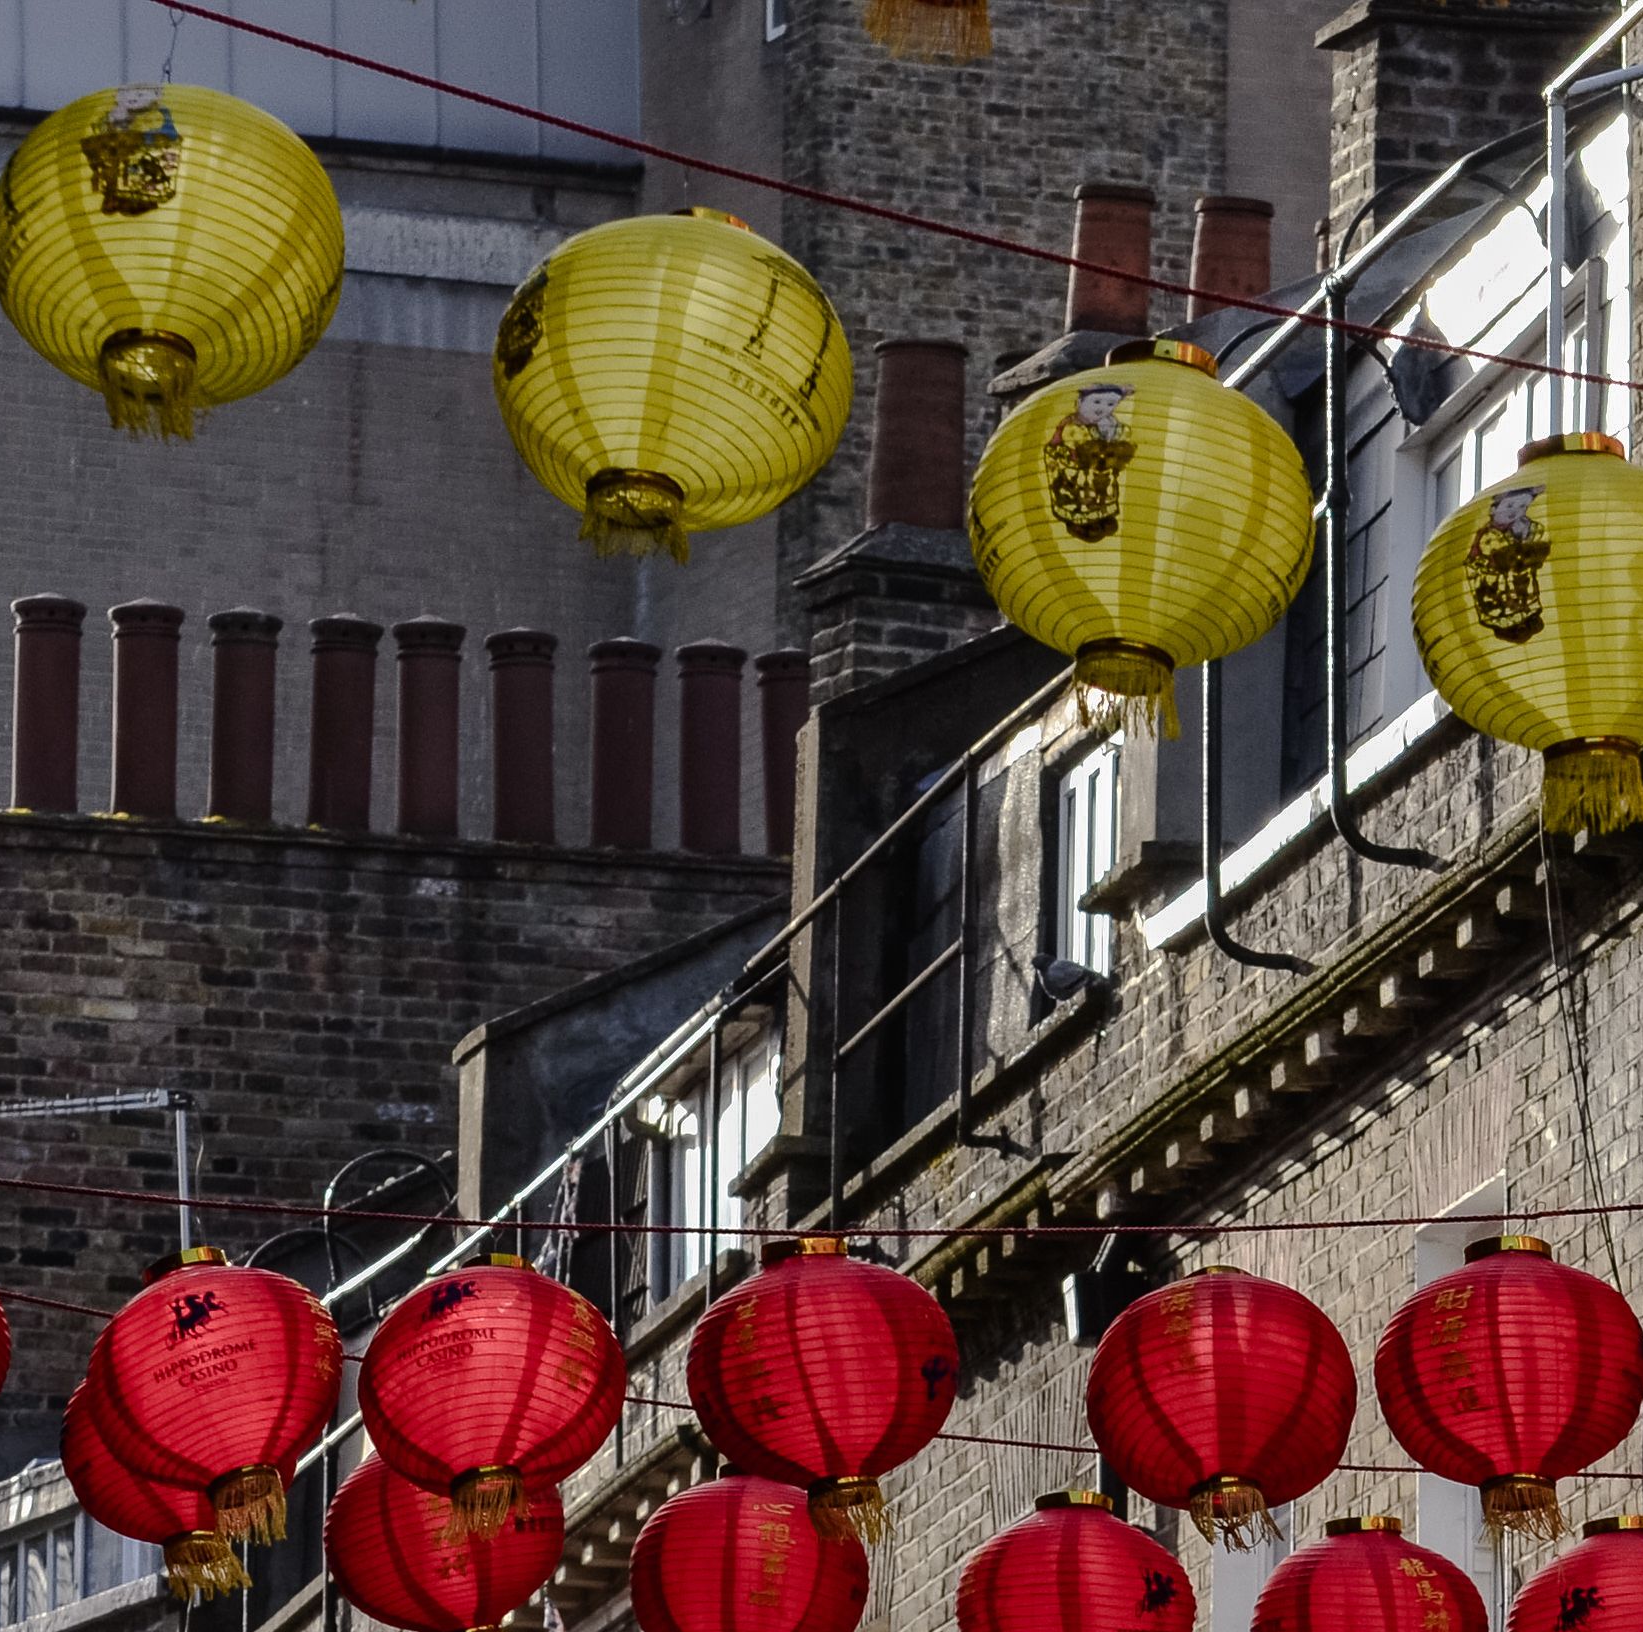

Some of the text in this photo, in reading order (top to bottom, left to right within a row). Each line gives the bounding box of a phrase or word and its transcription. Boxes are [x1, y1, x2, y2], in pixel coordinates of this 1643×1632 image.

[152, 1339, 259, 1385] HIPPODROME
[397, 1329, 498, 1363] HIPPODROME
[415, 1343, 474, 1369] CASINO
[178, 1352, 239, 1388] CASINO
